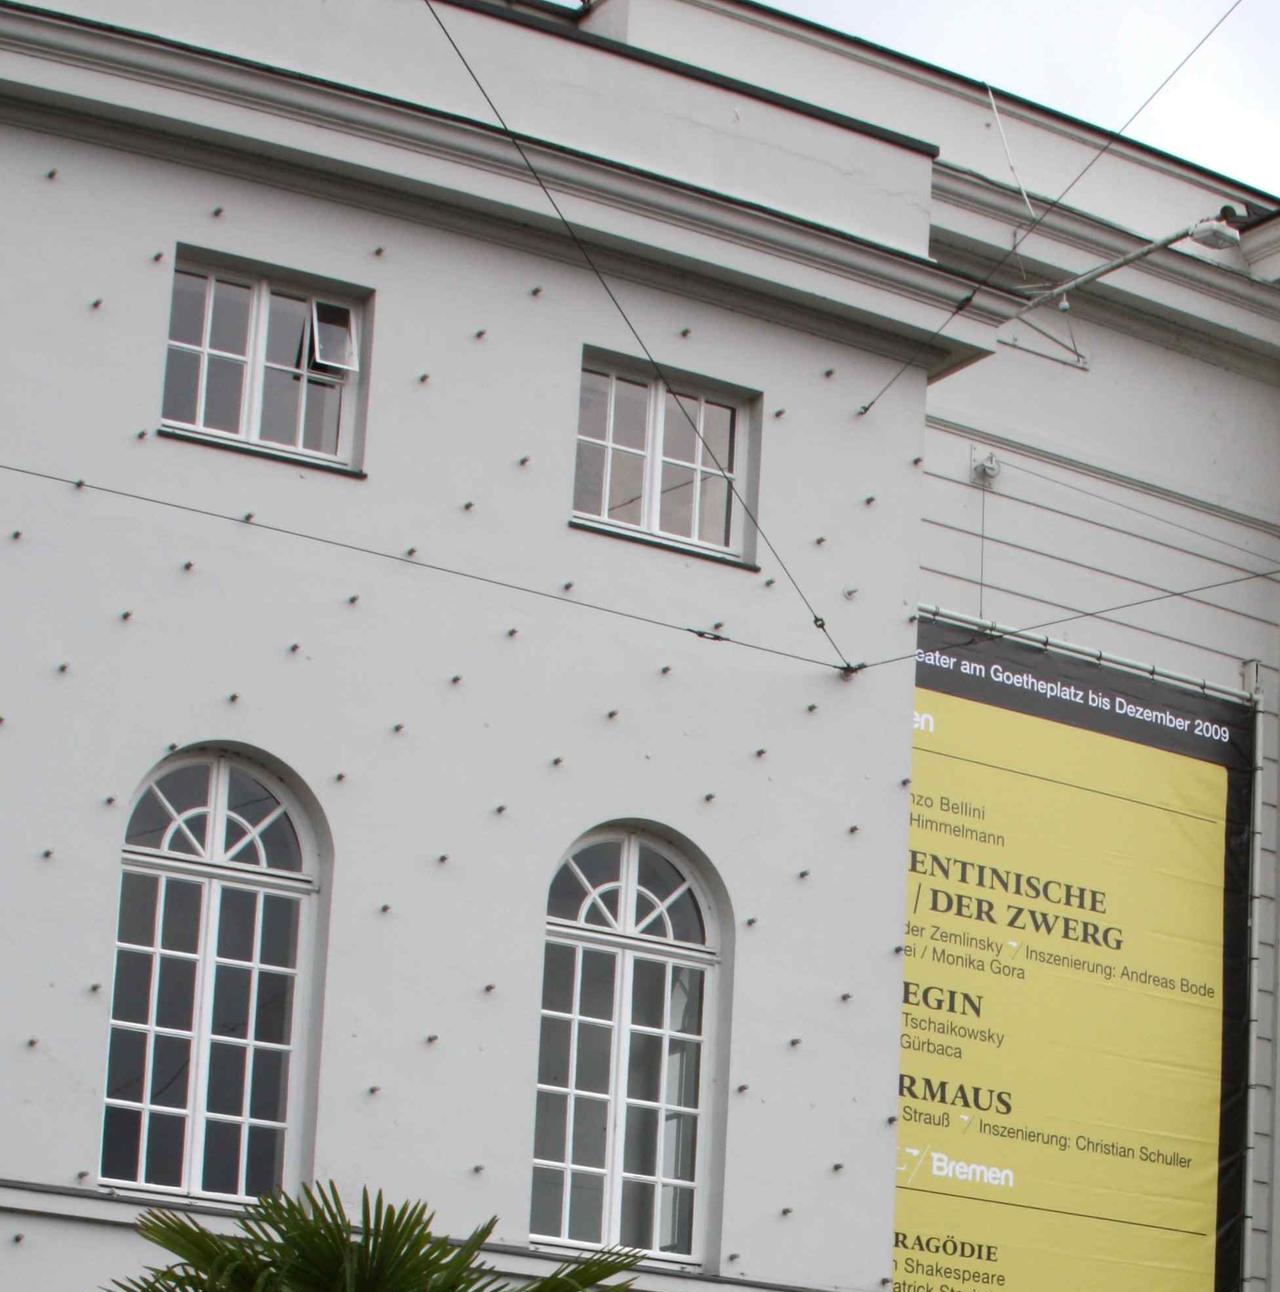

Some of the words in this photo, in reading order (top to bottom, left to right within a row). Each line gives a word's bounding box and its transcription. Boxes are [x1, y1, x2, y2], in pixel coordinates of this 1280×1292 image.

[960, 659, 986, 678] am
[990, 664, 1084, 704] Goetheplatz
[1088, 689, 1111, 711] bis
[1115, 696, 1191, 732] Dezember
[1194, 719, 1230, 743] 2009
[939, 796, 986, 821] Bellini
[909, 811, 1005, 848] Himmelmann
[908, 849, 1107, 915] ENTINISCHE
[929, 887, 998, 925] DER
[1006, 904, 1124, 951] ZWERG
[929, 923, 1004, 958] Zemlinsky
[1025, 944, 1117, 981] Inszenierung:
[1120, 965, 1176, 991] Andreas
[1179, 977, 1215, 999] Bode
[932, 945, 985, 972] Monika
[989, 958, 1026, 981] Gora
[902, 981, 984, 1019] EGIN
[899, 1032, 963, 1060] Gürbaca
[902, 1011, 1005, 1049] Tschaikowsky
[898, 1073, 1013, 1116] RMAUS
[902, 1105, 951, 1129] Strauß
[978, 1118, 1071, 1151] Inszenierung:
[1075, 1135, 1136, 1160] Christian
[1138, 1146, 1193, 1170] Schuller
[930, 1151, 1014, 1188] Bremen
[893, 1231, 999, 1263] RAGÖDIE
[903, 1257, 1006, 1287] Shakespeare
